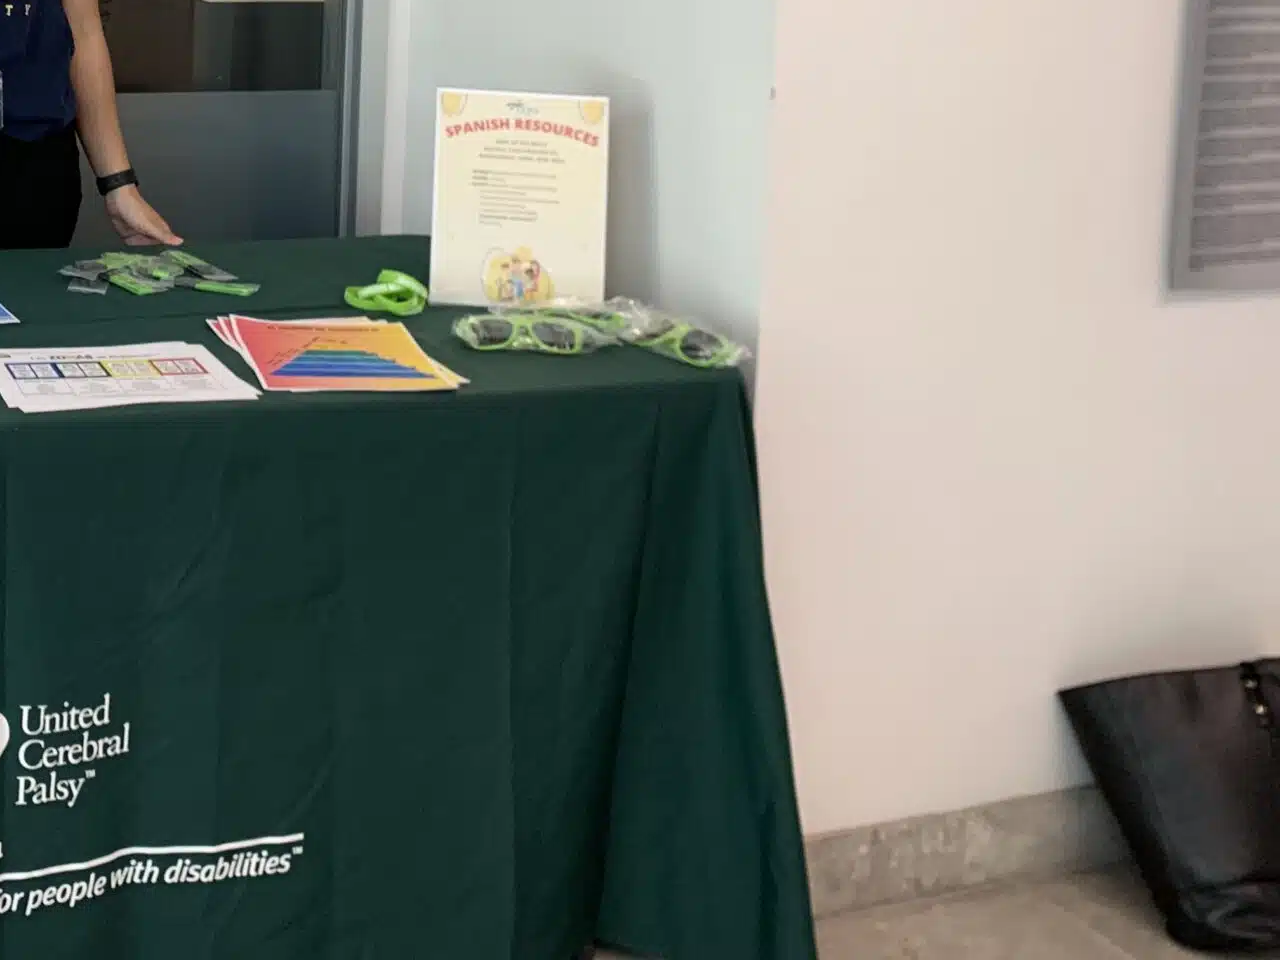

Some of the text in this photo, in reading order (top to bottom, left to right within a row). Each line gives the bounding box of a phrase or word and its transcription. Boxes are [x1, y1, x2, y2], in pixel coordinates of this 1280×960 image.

[445, 118, 510, 138] SPANISH
[514, 118, 600, 147] RESOURCES
[20, 692, 111, 735] United
[18, 723, 130, 770] Cerebral
[25, 872, 108, 917] people
[110, 858, 160, 889] with
